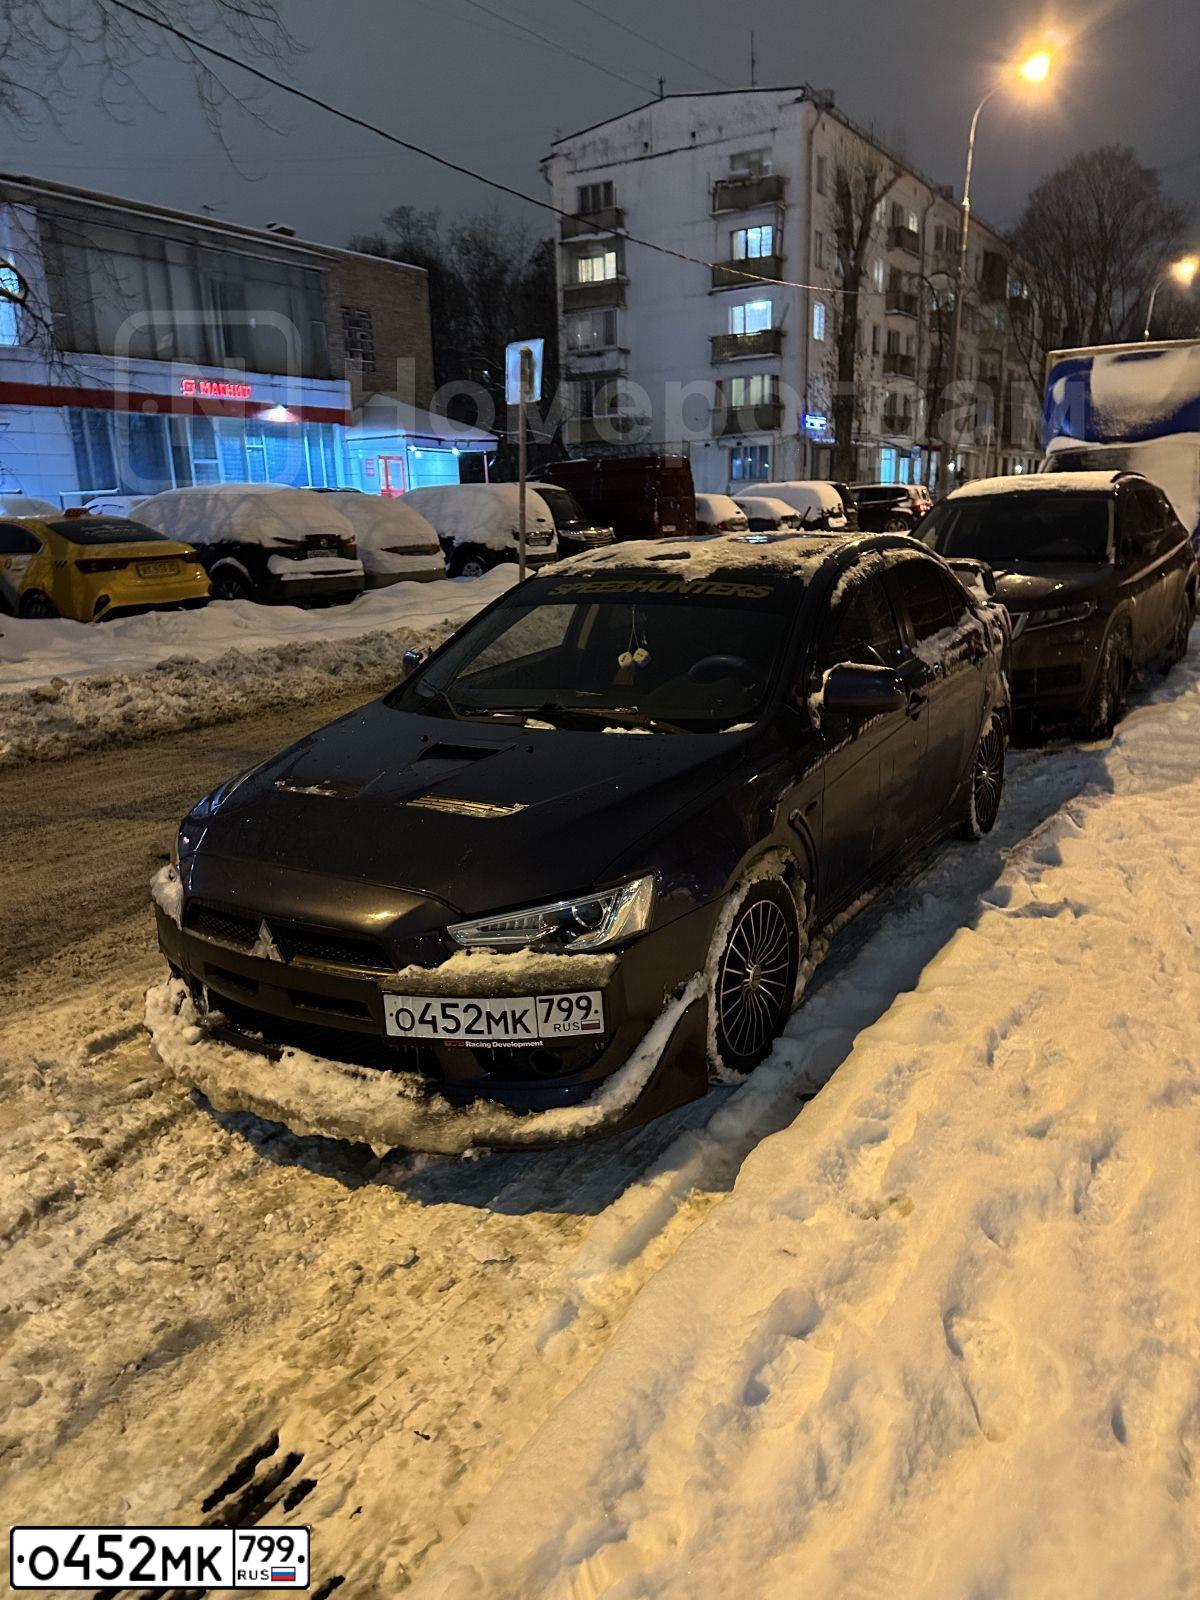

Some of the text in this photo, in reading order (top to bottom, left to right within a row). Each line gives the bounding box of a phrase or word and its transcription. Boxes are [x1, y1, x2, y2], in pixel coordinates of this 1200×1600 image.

[200, 381, 251, 398] МАГНИТ
[549, 580, 774, 598] SPEEDHUNTERS
[395, 995, 593, 1035] О452МК 799
[553, 1021, 580, 1033] RUS
[465, 1040, 492, 1049] Racing
[492, 1040, 544, 1049] Development
